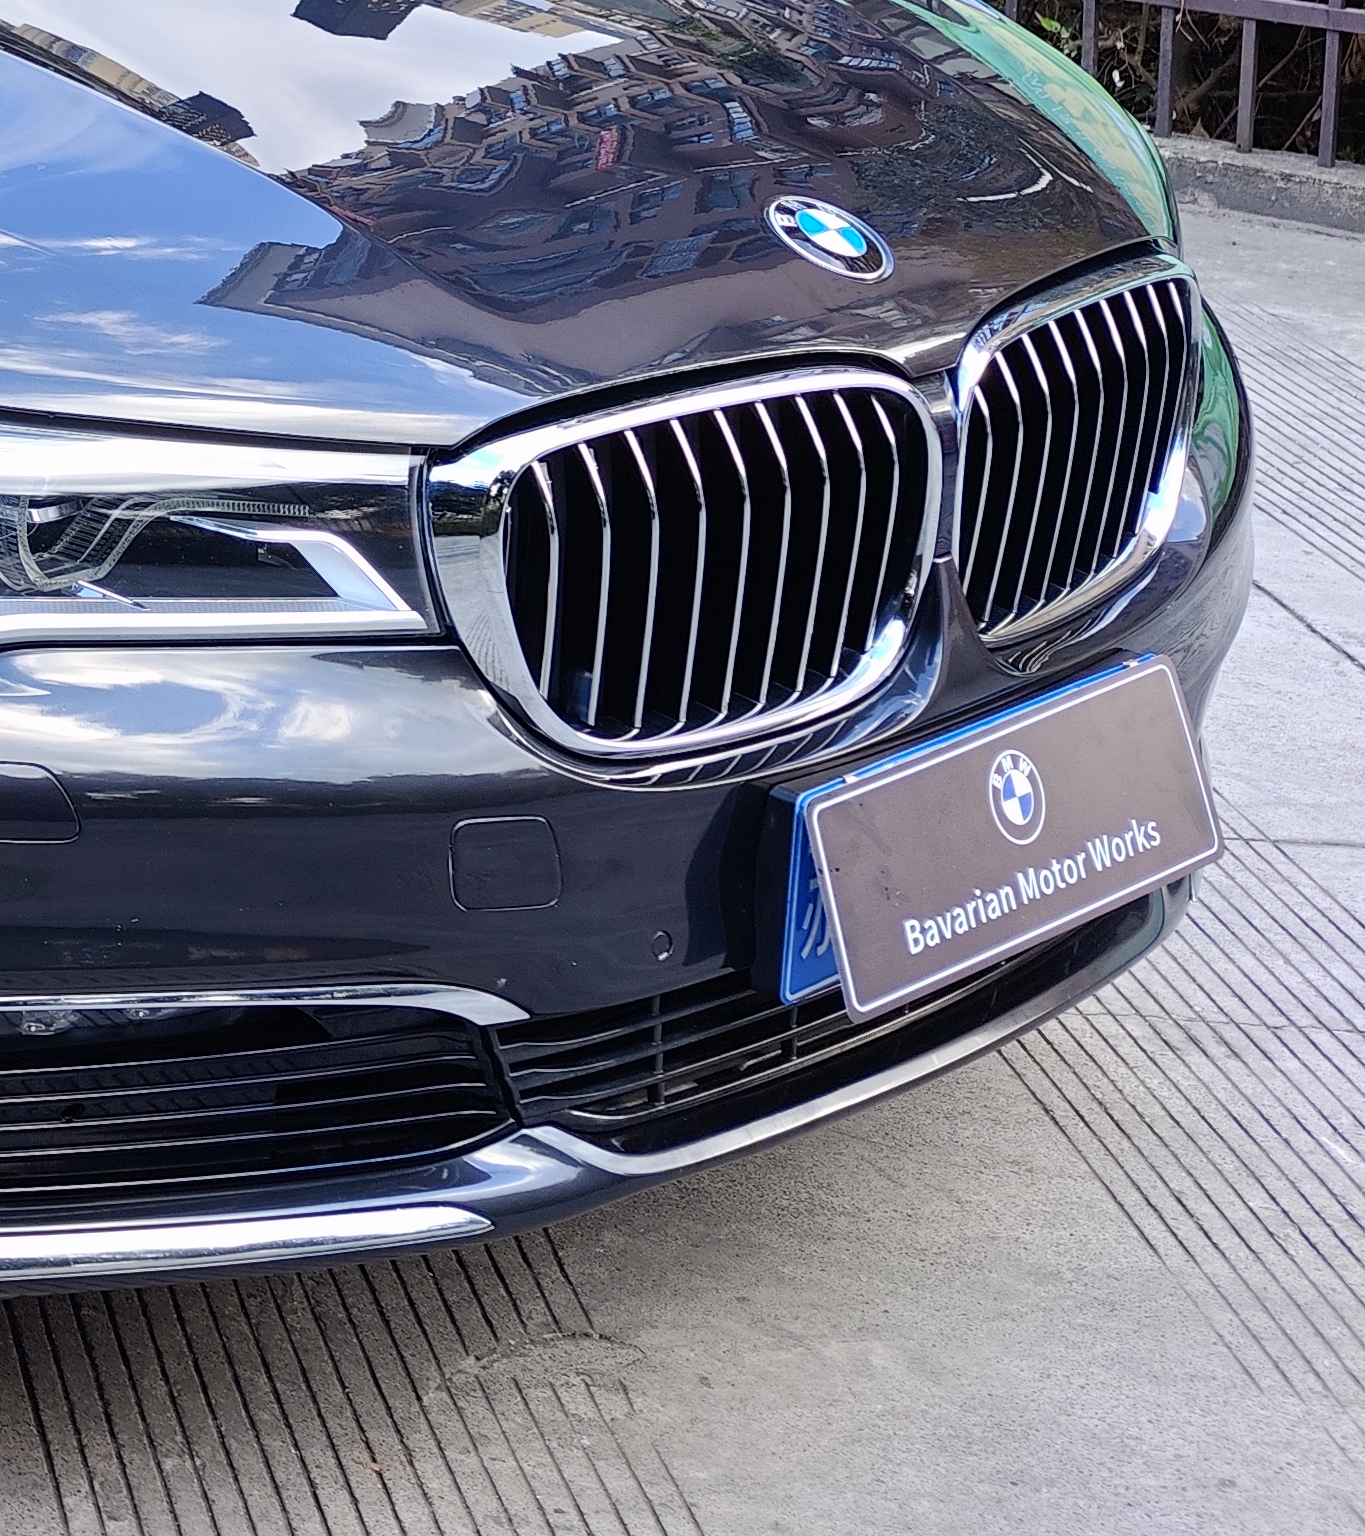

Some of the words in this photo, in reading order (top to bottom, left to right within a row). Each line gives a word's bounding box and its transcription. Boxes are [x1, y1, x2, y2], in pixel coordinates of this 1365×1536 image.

[904, 888, 1017, 955] Bavarian
[1017, 851, 1087, 904] Motor
[1087, 819, 1161, 872] Works
